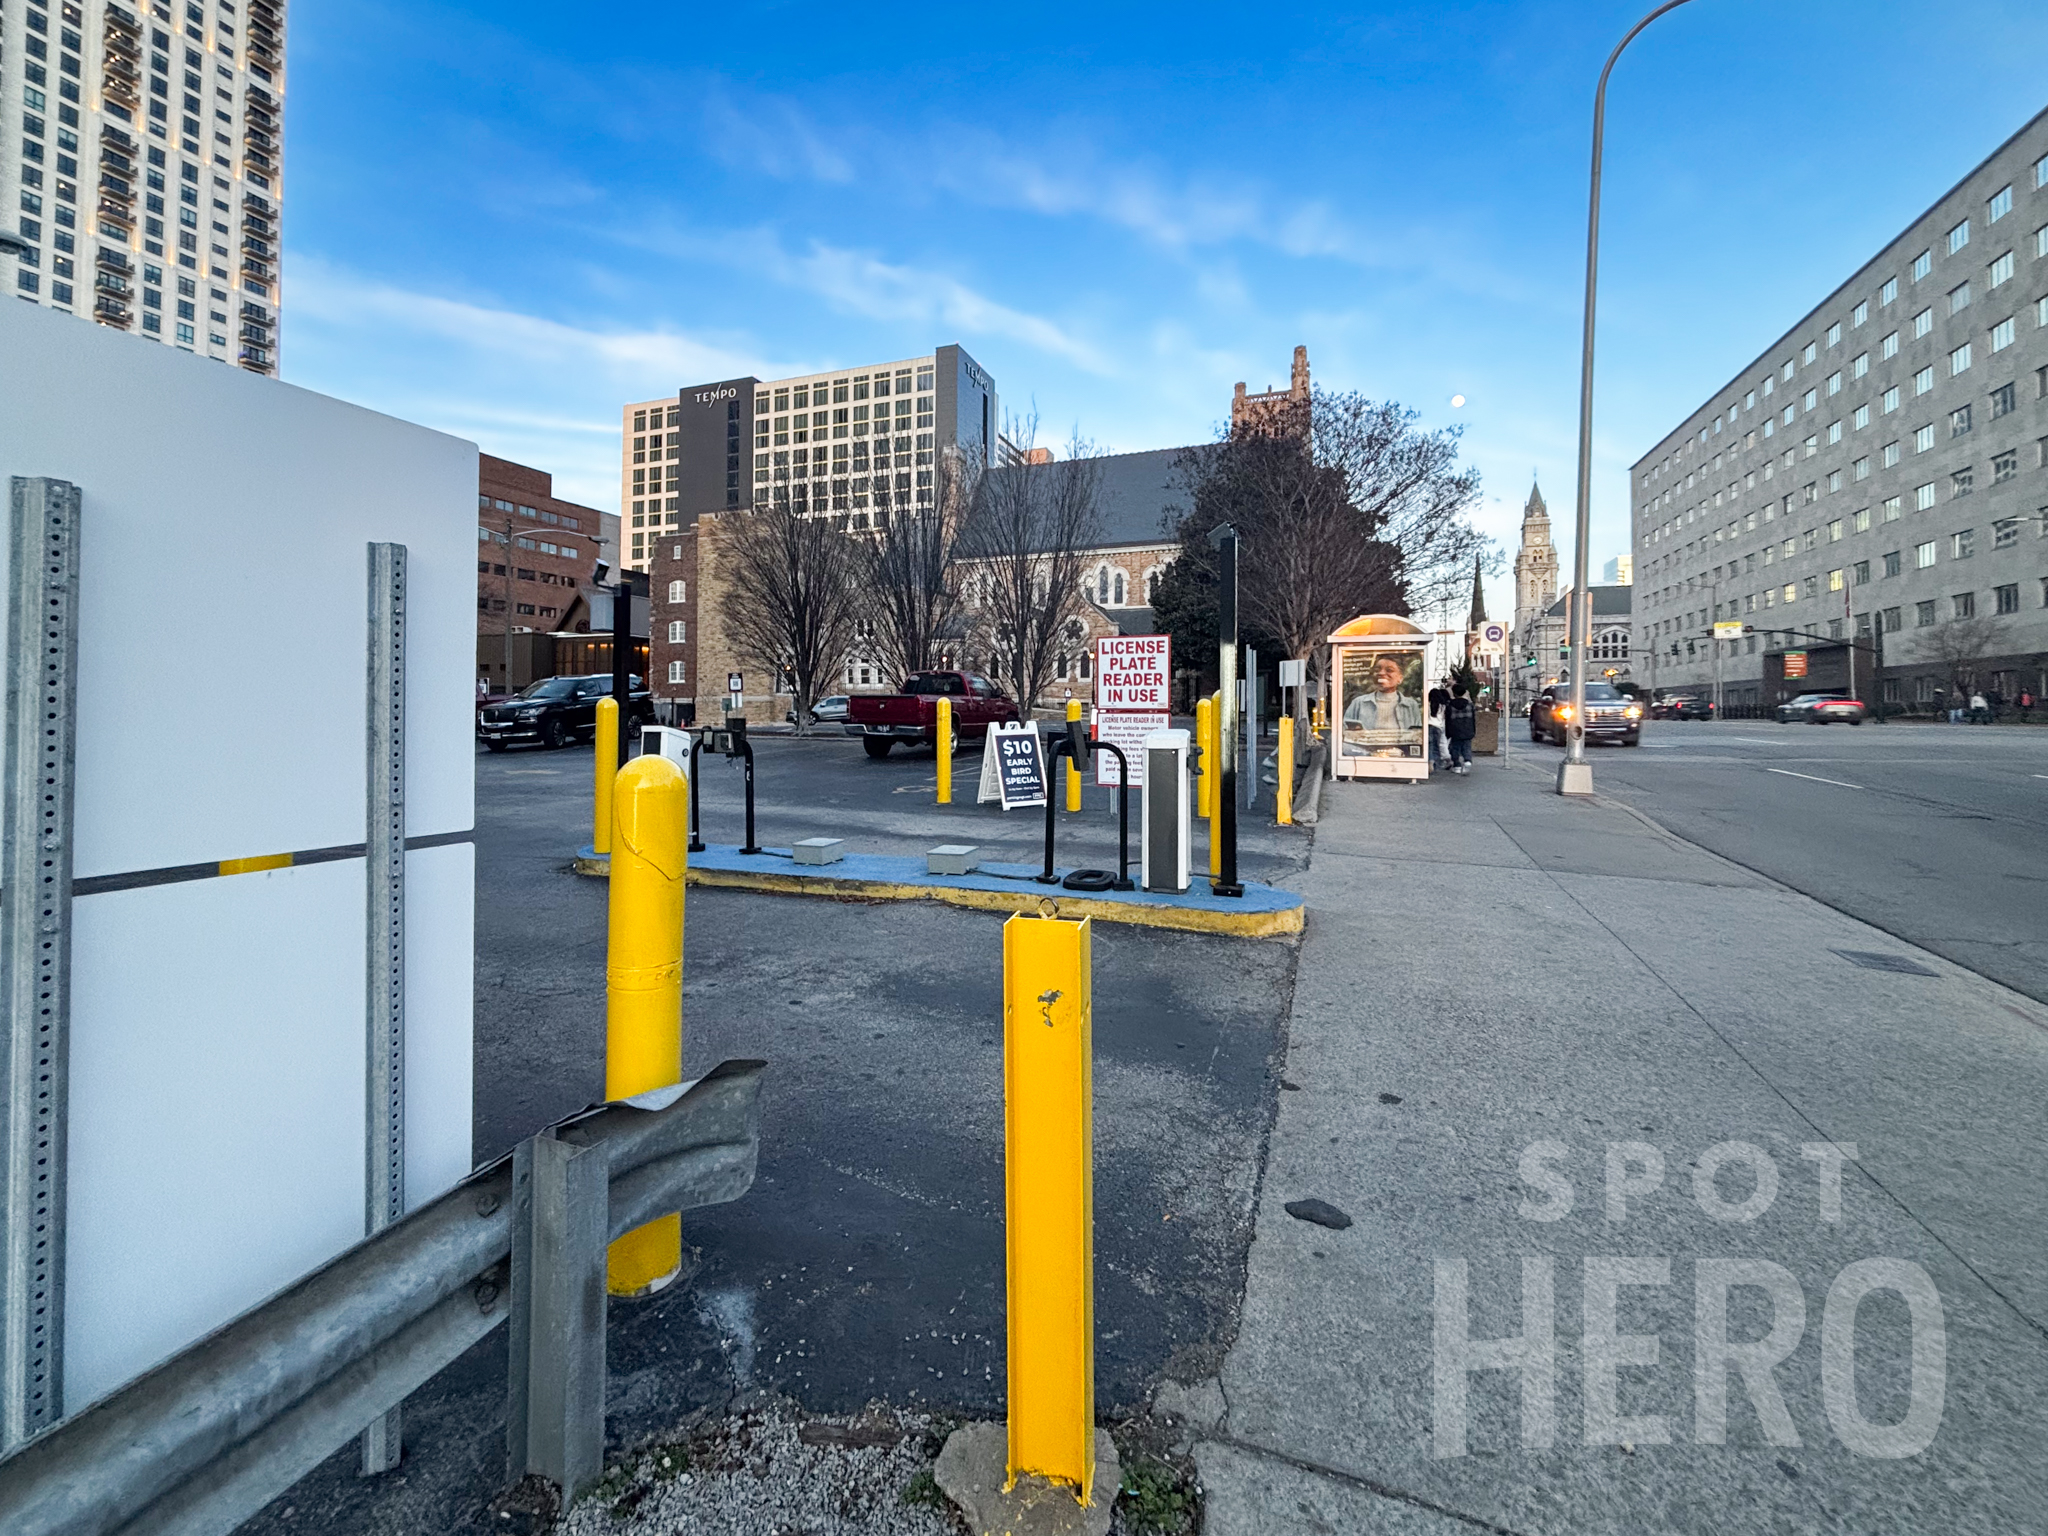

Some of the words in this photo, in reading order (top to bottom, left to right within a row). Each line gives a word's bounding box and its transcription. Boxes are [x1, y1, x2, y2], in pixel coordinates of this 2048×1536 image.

[965, 362, 989, 391] TEMPO
[694, 384, 737, 407] TEMPO
[1101, 640, 1166, 655] LICENSE
[1109, 656, 1157, 671] PLATE
[1103, 672, 1164, 687] READER
[1108, 689, 1123, 702] IN
[1128, 689, 1159, 702] USE
[1002, 739, 1032, 757] $10
[1006, 758, 1033, 766] EARLY
[1010, 767, 1032, 775] BIRD
[1005, 775, 1040, 785] SPECIAL
